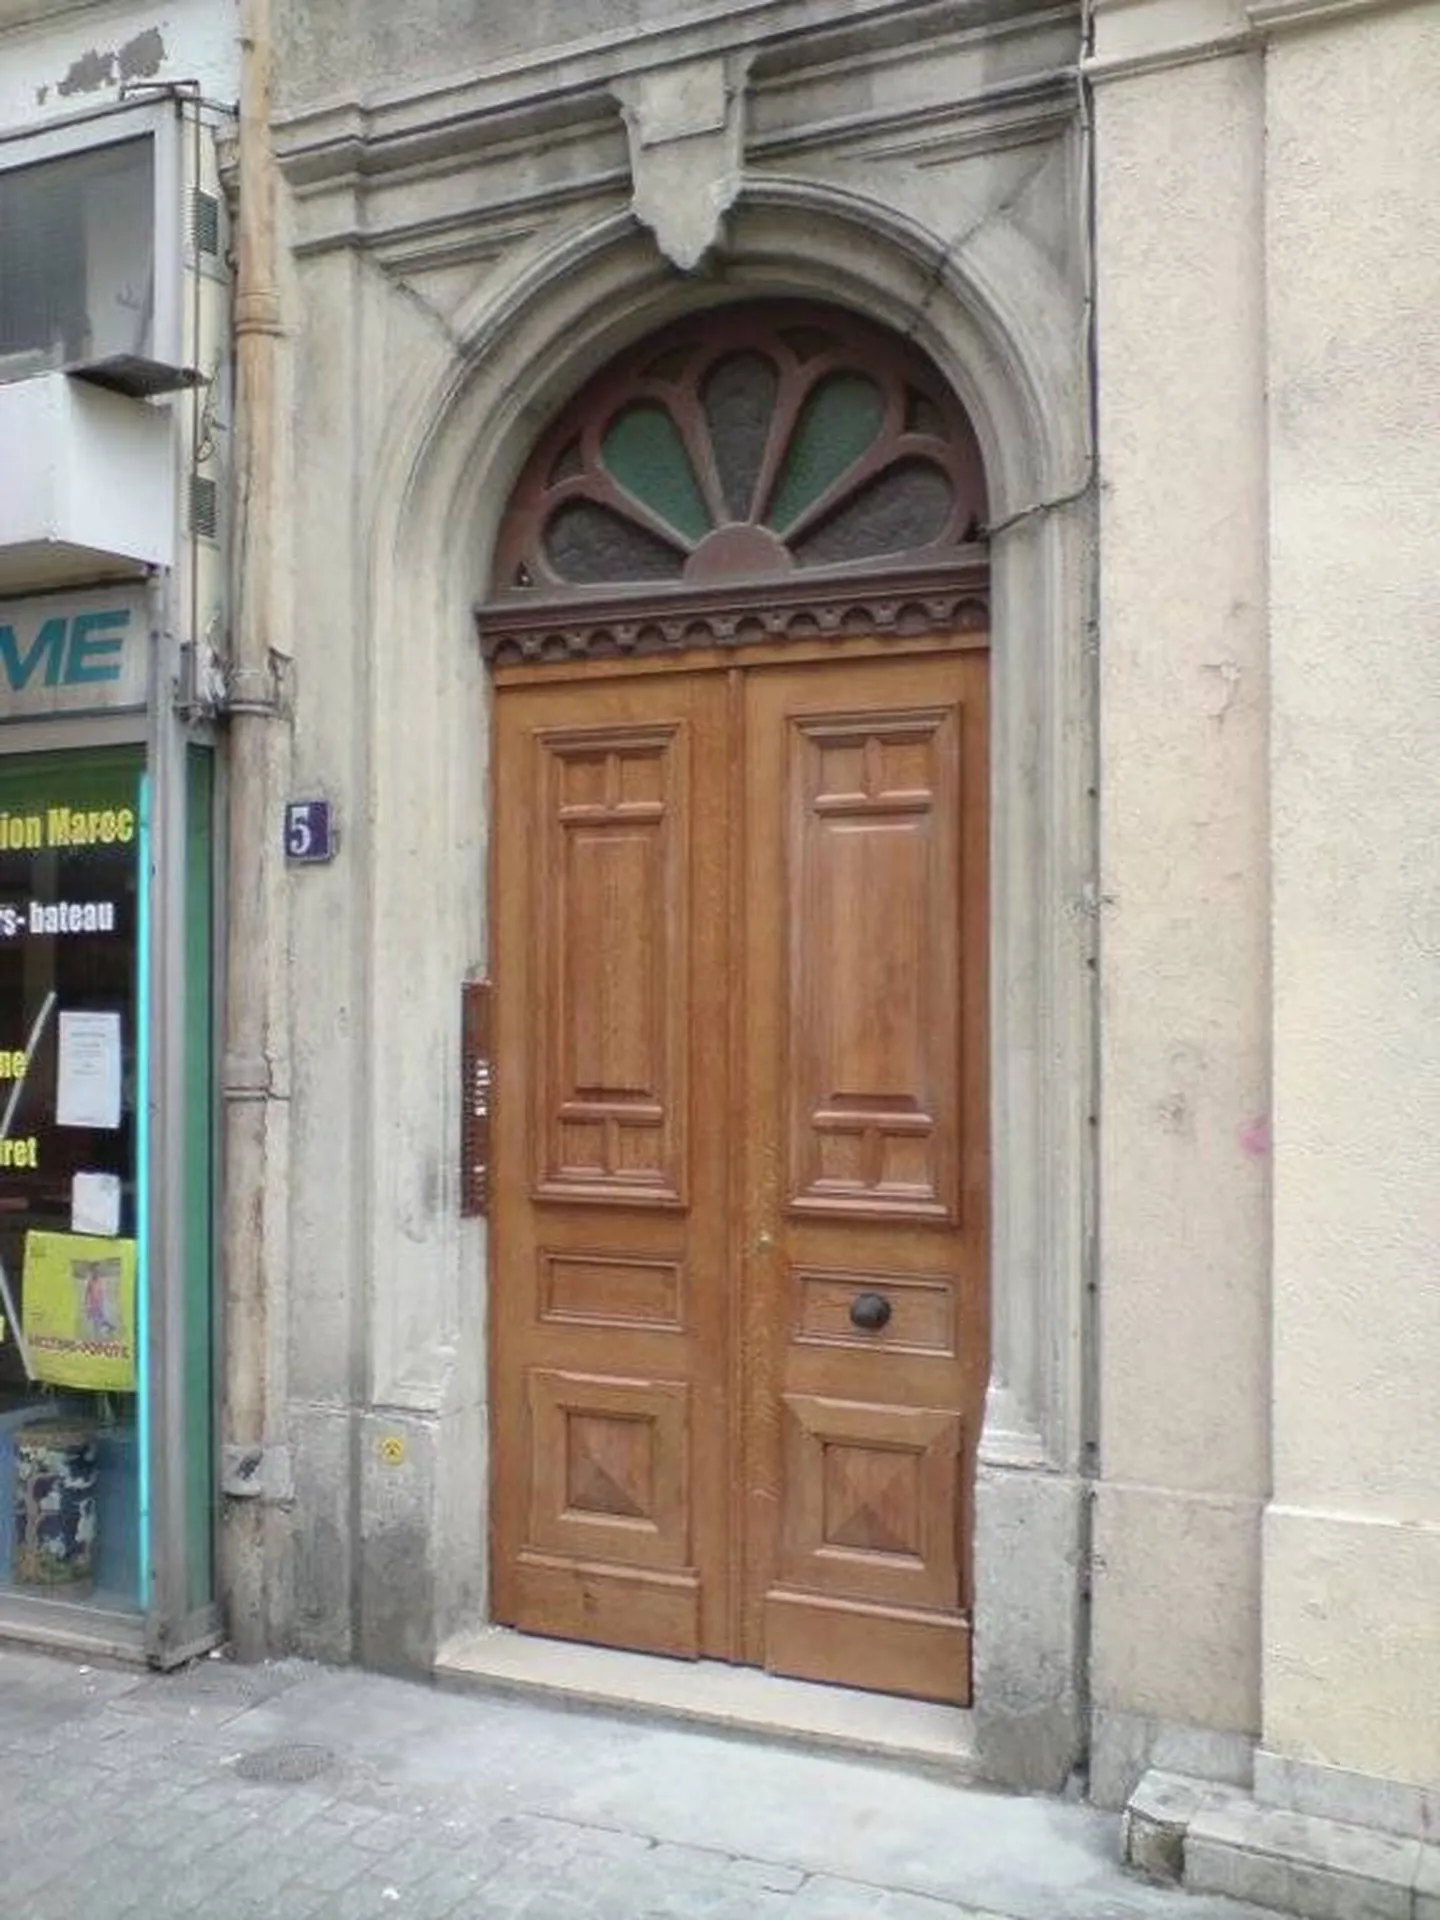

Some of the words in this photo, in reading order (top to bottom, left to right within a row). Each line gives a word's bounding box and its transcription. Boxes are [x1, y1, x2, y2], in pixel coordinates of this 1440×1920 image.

[0, 609, 131, 692] ME
[47, 807, 134, 846] Maroc
[290, 806, 311, 855] 5
[29, 901, 114, 933] bateau
